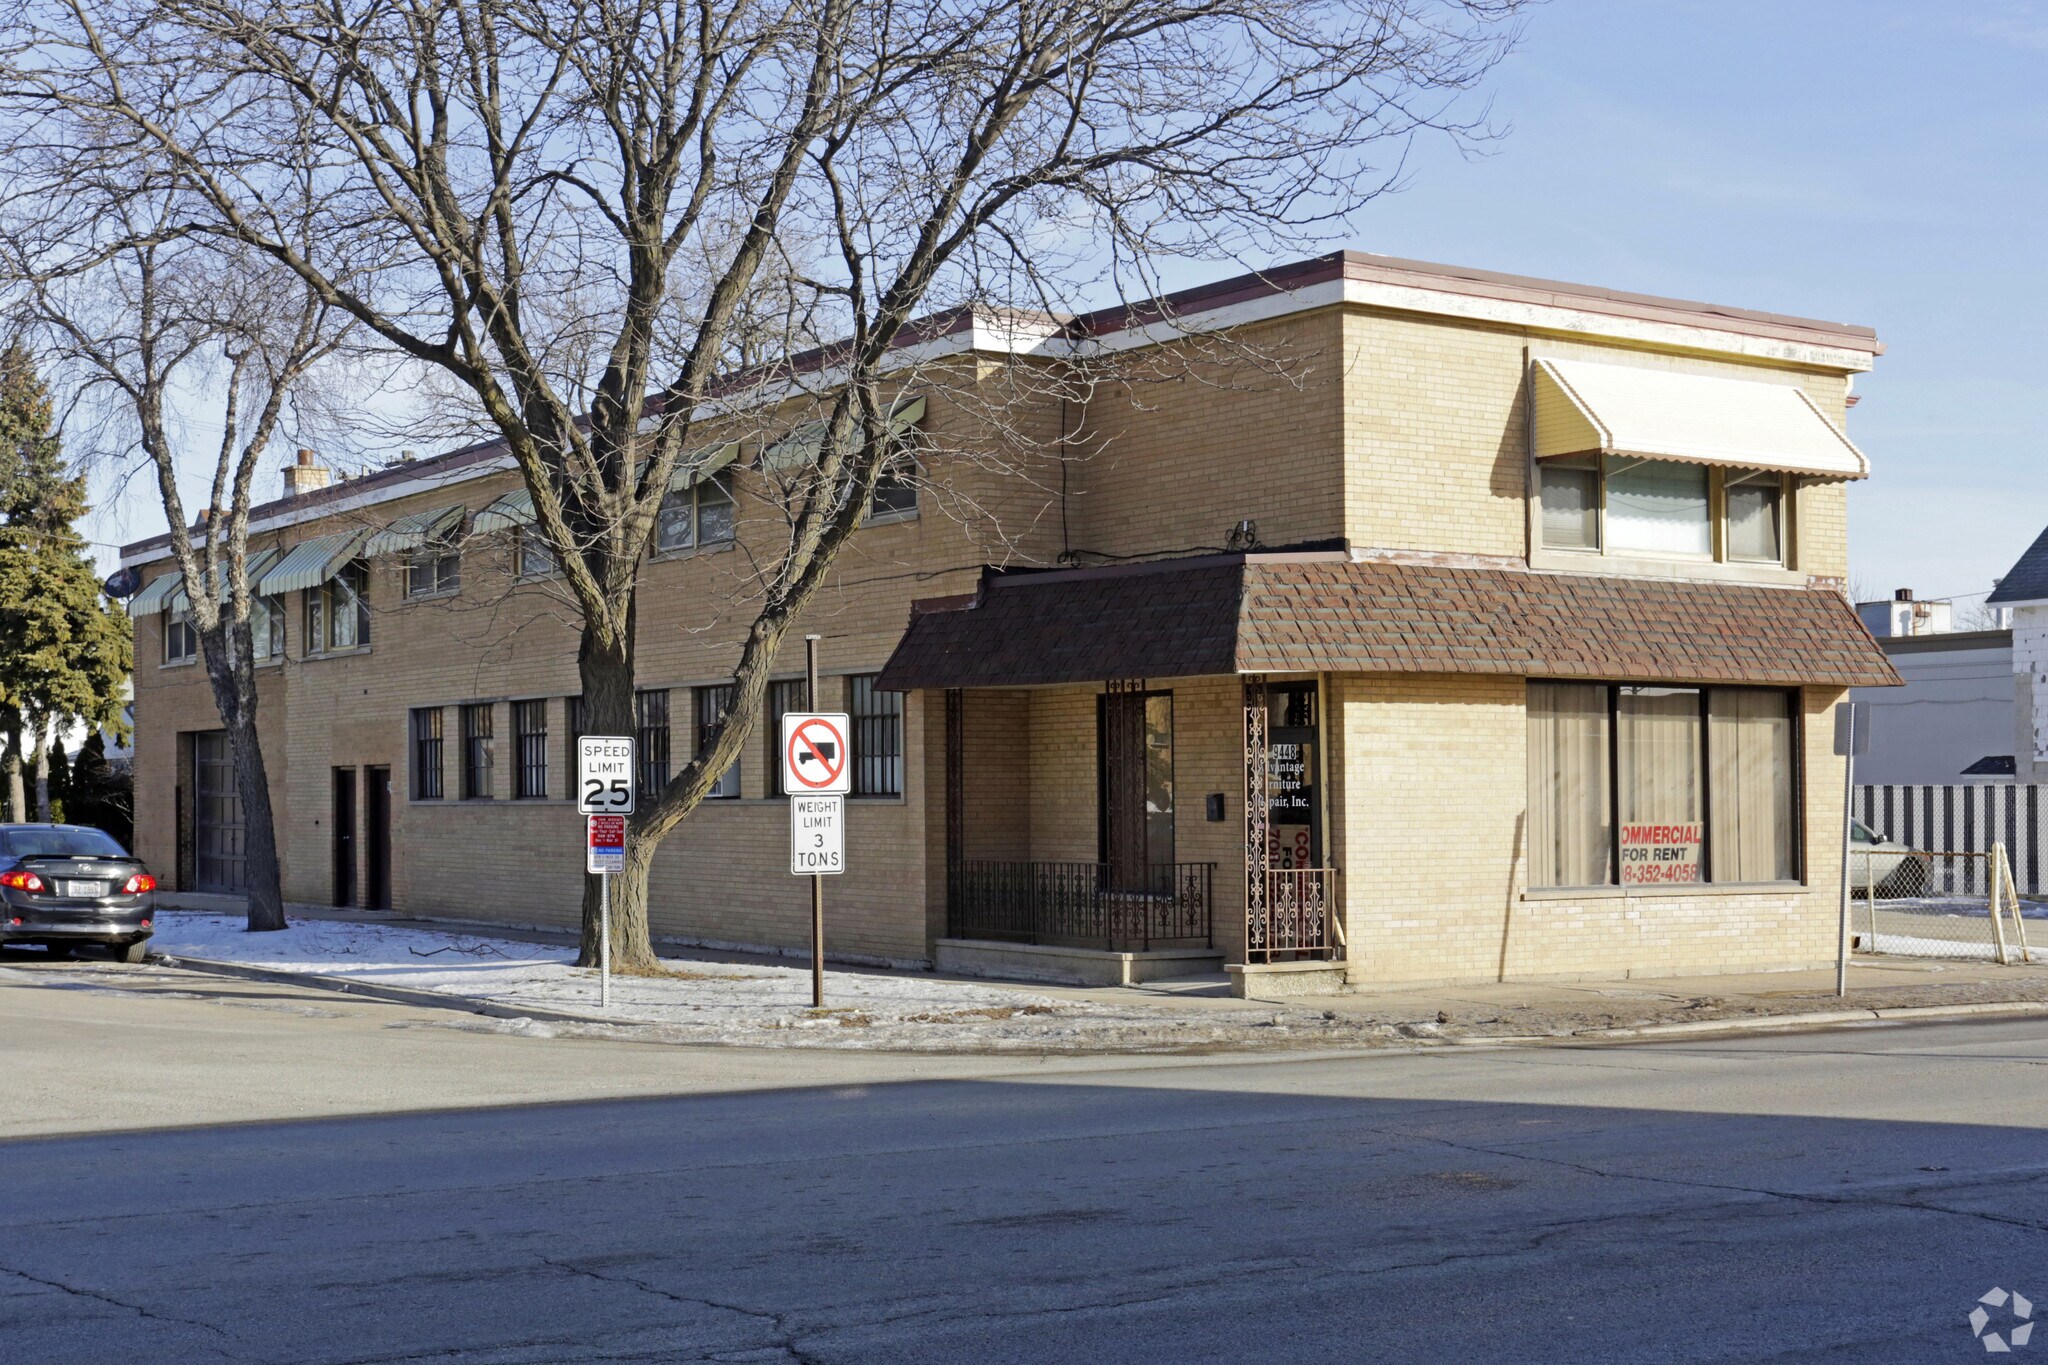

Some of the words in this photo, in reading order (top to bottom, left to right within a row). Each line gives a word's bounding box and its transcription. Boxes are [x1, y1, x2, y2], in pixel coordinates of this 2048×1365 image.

[584, 746, 630, 757] SPEED
[1273, 745, 1296, 759] 9448
[589, 762, 625, 773] LIMIT
[1260, 761, 1305, 776] vntage
[1260, 779, 1301, 789] rniture
[584, 779, 630, 807] 25
[797, 801, 838, 813] WEIGHT
[1260, 795, 1289, 809] pair,
[1291, 795, 1309, 807] Inc.
[803, 816, 832, 828] LIMIT
[814, 833, 824, 848] 3
[1621, 825, 1702, 845] OMMERCIAL
[798, 852, 839, 867] TONS
[1623, 848, 1648, 861] FOR
[1653, 847, 1688, 861] RENT
[1624, 864, 1699, 883] 8-352-4058
